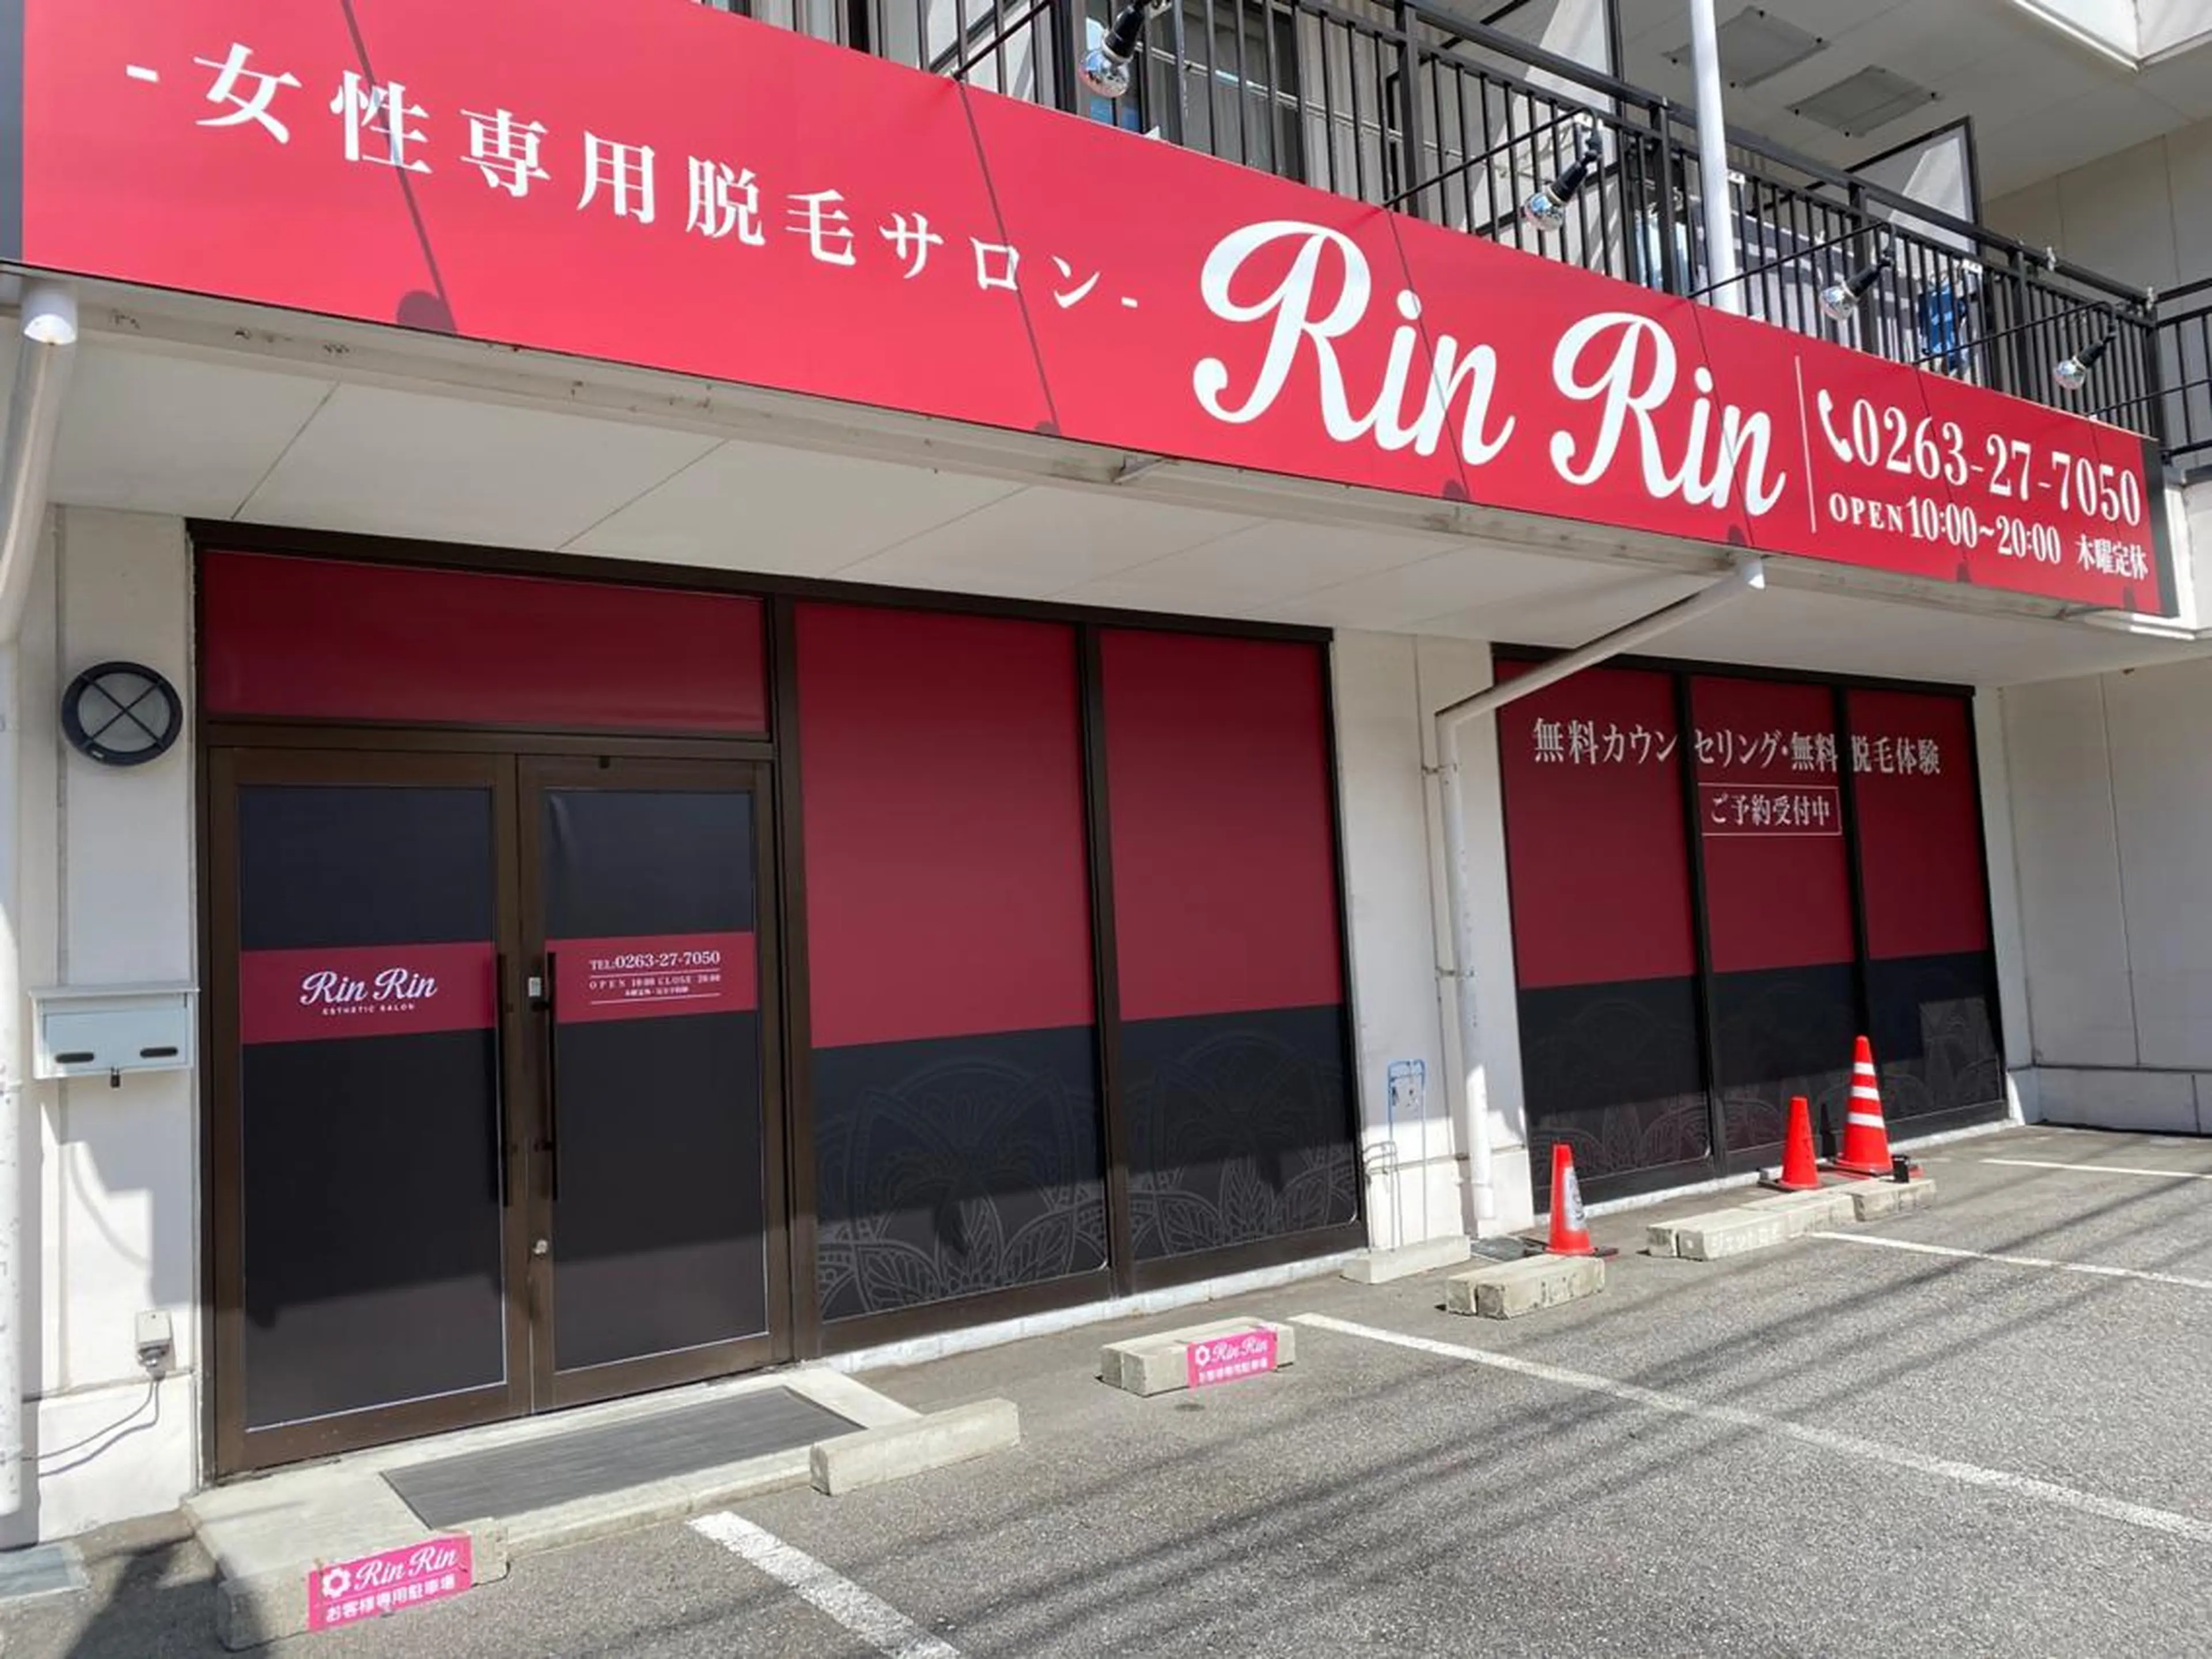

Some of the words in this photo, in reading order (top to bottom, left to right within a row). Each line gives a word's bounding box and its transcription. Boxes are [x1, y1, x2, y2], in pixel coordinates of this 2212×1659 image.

[1193, 221, 1515, 465] Rin
[1550, 312, 1786, 516] Rin
[1852, 399, 2141, 527] 0263-27-7050
[2075, 533, 2149, 581] 木曜定休
[1711, 793, 1830, 827] ご予約受付中
[300, 971, 368, 1006] Rin
[372, 967, 437, 1001] Rin
[353, 1559, 406, 1592] Rin
[408, 1545, 459, 1577] Rin
